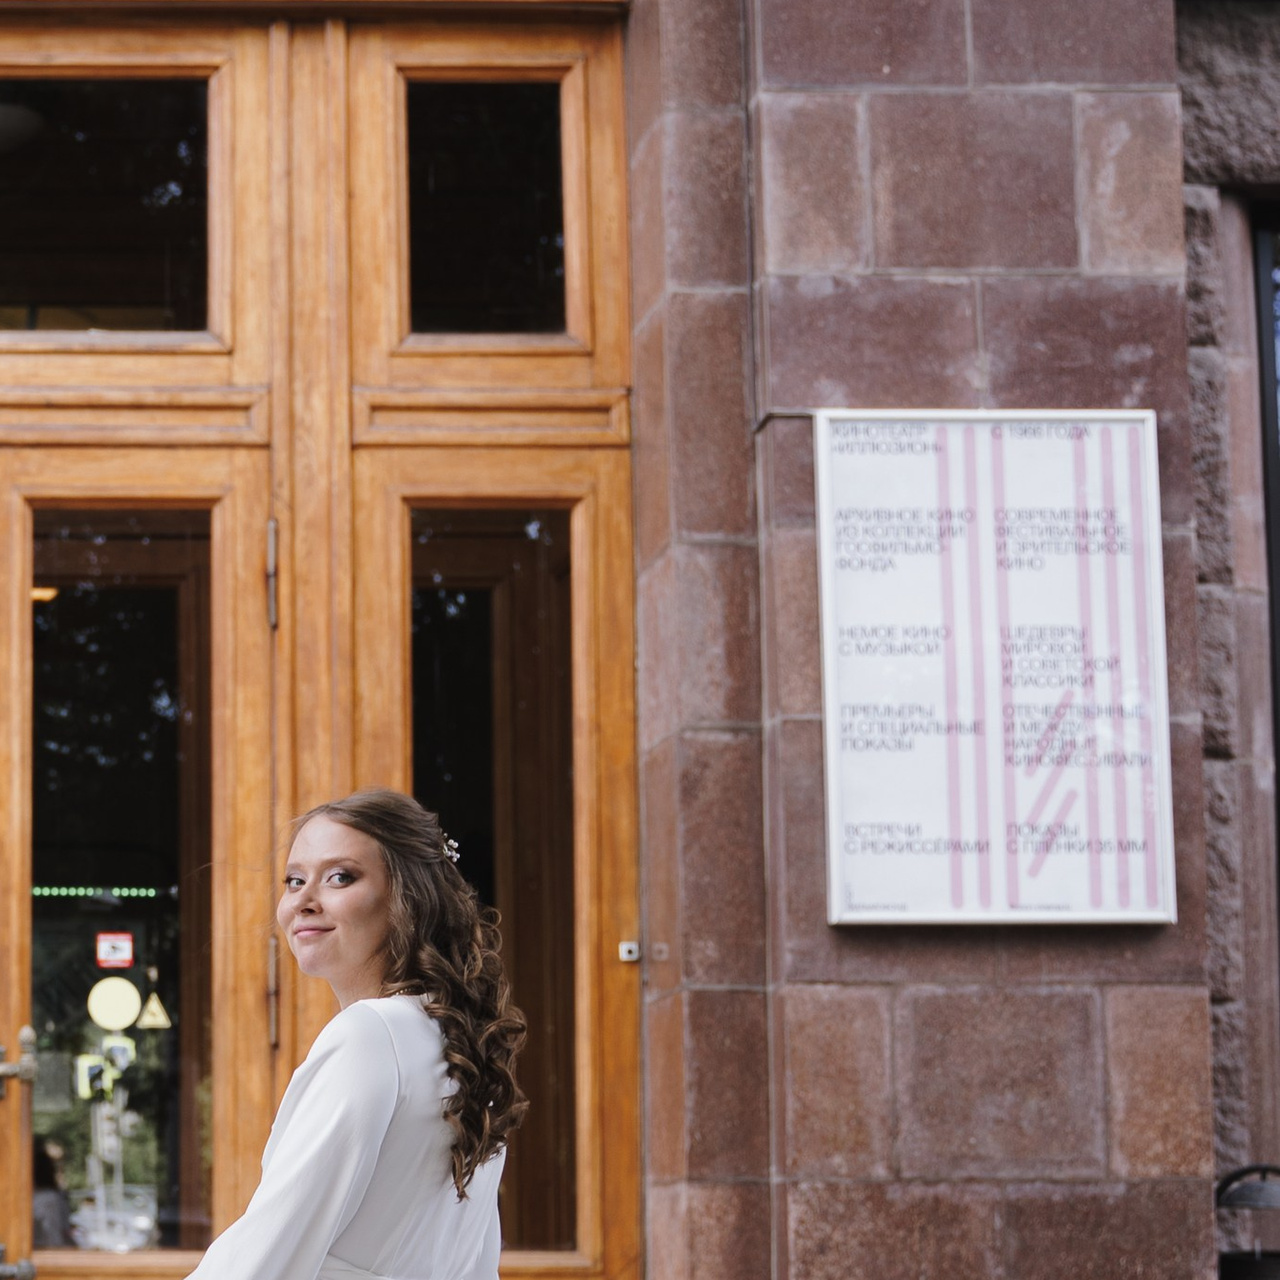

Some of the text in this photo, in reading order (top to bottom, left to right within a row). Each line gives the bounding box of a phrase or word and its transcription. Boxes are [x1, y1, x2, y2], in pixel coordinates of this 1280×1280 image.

[832, 423, 927, 438] КИНОТЕАТР
[1047, 424, 1090, 440] ГОДА
[835, 507, 976, 522] АРХИВНОЕ КИНО
[994, 508, 1120, 523] СОВРЕМЕННОЕ
[862, 524, 966, 540] КОЛЛЕКЦИИ
[994, 523, 1127, 539] ФЕСТИВАЛЬНОЕ
[1011, 540, 1132, 555] ЗРИТЕЛЬСКОЕ
[835, 556, 896, 572] ФОНДА
[996, 556, 1045, 571] КИНО
[839, 625, 952, 640] НЕМОЕ КИНО
[1000, 625, 1088, 642] ШЕДЕВРЫ
[855, 640, 941, 656] МУЗЫКОЙ
[1001, 640, 1087, 656] МИРОВОЙ
[1018, 656, 1120, 672] СОВЕТСКОЙ
[1002, 674, 1094, 688] КЛАССИКИ
[841, 703, 935, 718] ПРЕМЬЕРЫ
[857, 719, 985, 736] СПЕЦИАЛЬНЫЕ
[842, 737, 915, 752] ПОКАЗЫ
[845, 822, 922, 837] ВСТРЕЧИ
[1006, 822, 1079, 837] ПОКАЗЫ
[1117, 839, 1149, 854] ММ
